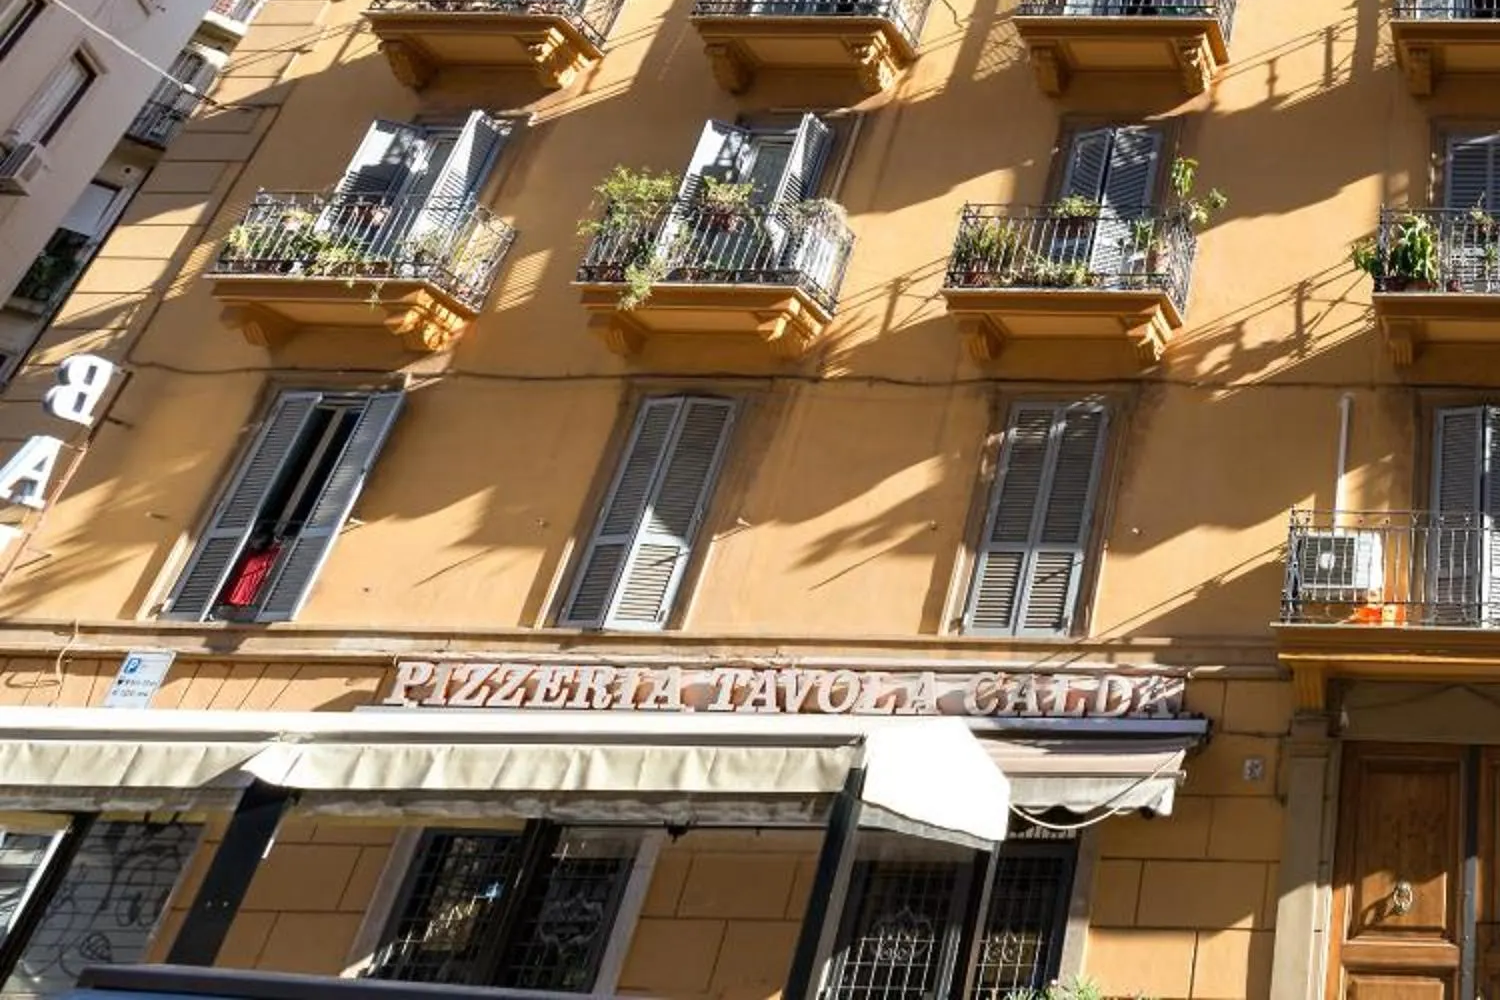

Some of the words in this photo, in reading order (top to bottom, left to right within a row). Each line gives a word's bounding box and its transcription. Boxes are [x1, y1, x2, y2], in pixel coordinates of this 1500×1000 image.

[383, 661, 695, 712] PIZZERIA
[706, 667, 943, 716] TAVOLA
[962, 671, 1180, 718] CALDA
